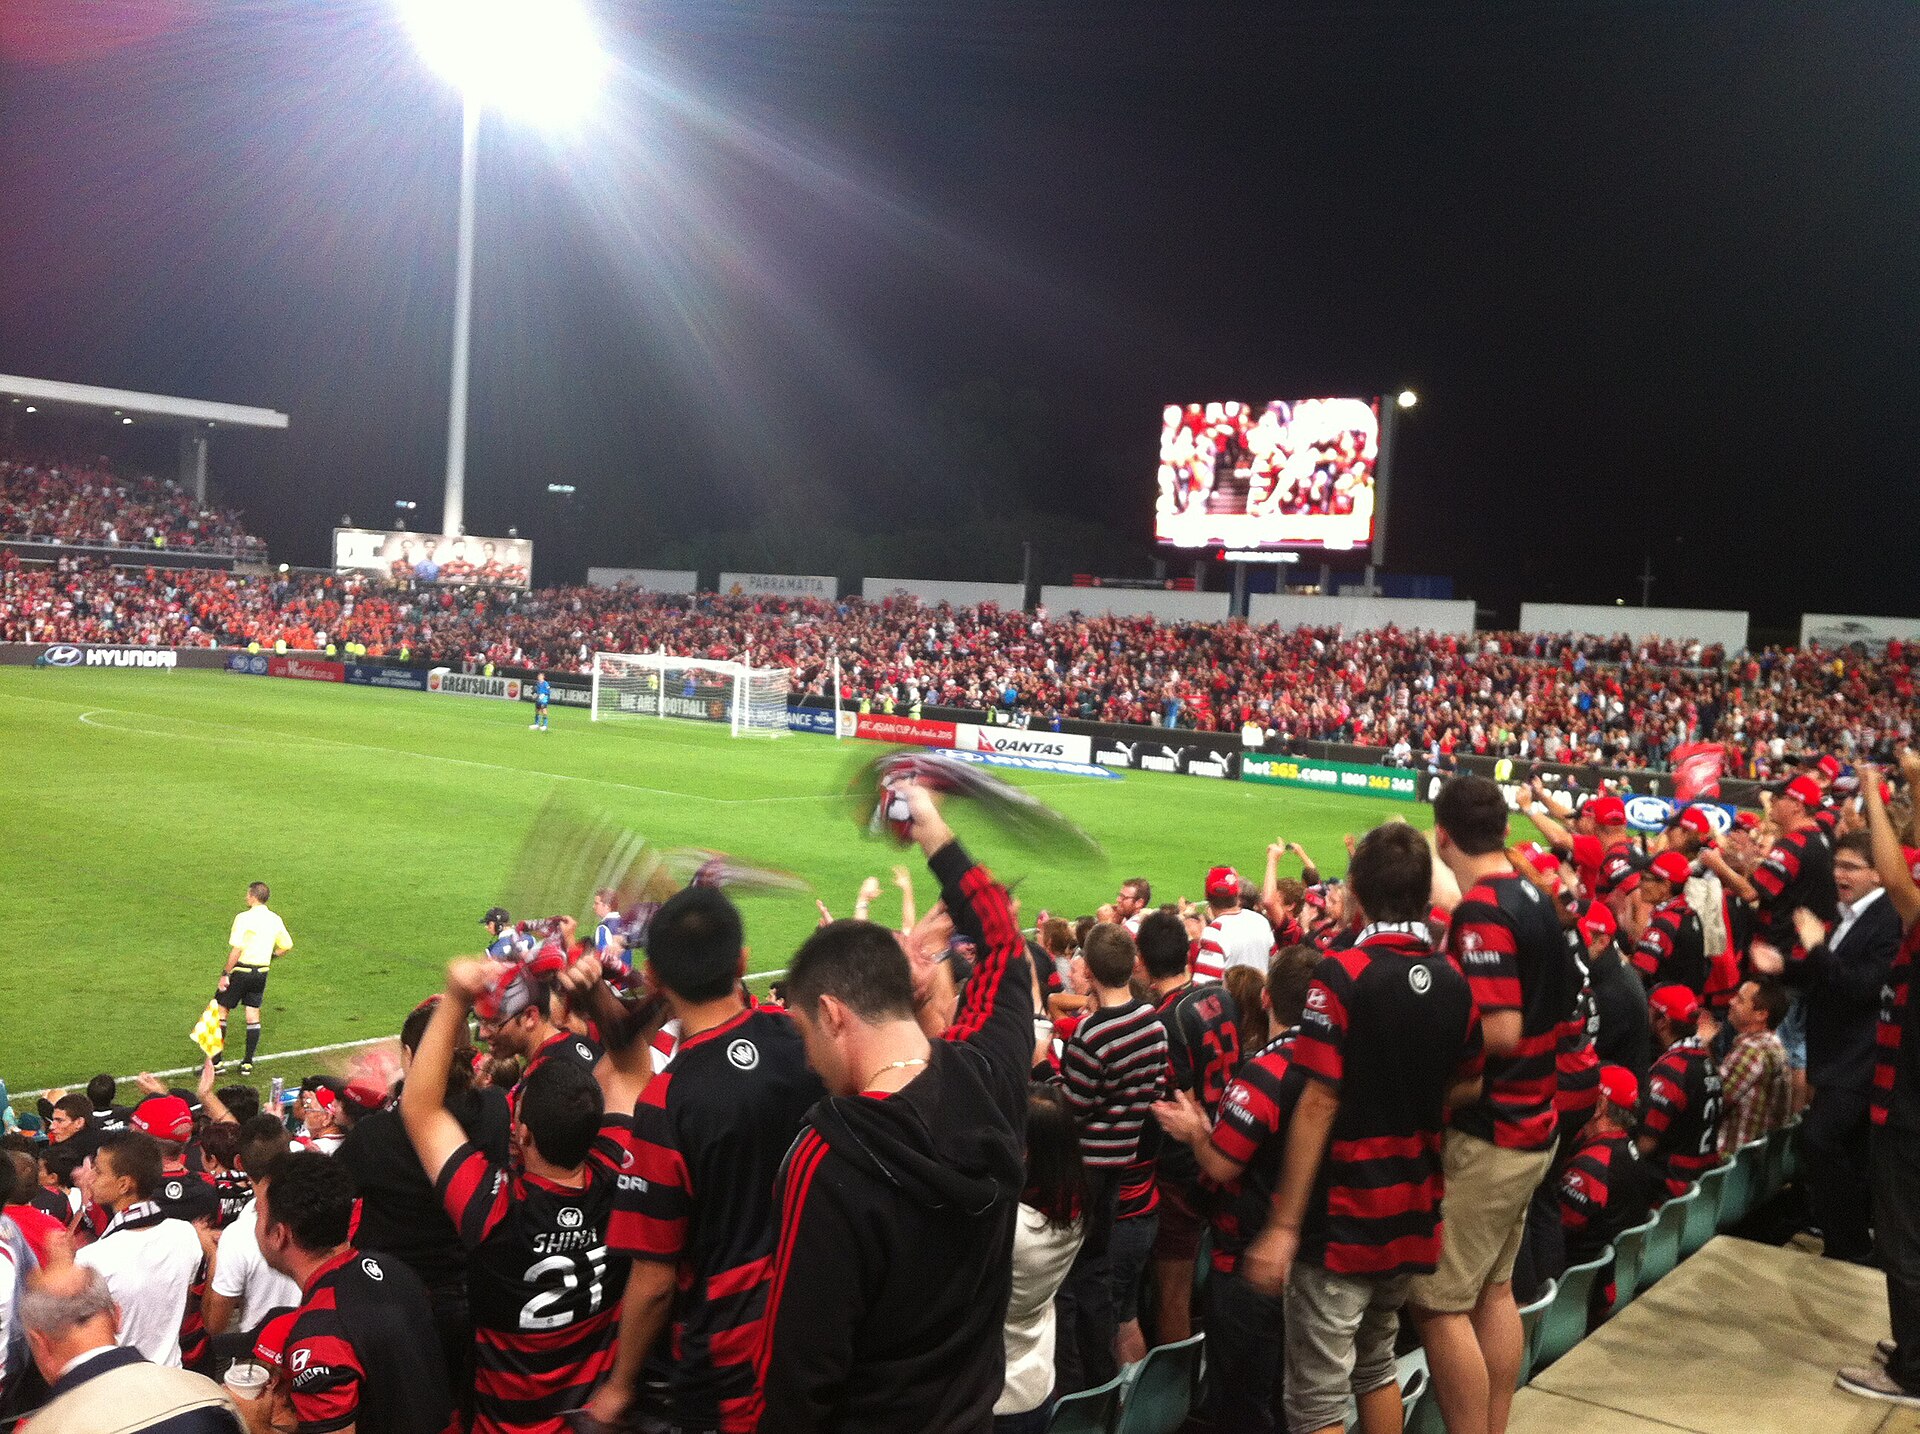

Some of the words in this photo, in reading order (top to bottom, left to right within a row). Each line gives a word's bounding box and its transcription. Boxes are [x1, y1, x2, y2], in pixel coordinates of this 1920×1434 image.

[750, 574, 823, 592] PARRAMATTA
[86, 649, 177, 667] HYUNDAI
[658, 696, 708, 718] OOTBALL
[995, 738, 1064, 756] QANTAS
[1243, 758, 1338, 785] bet365.com
[1368, 775, 1391, 789] 365
[1391, 777, 1414, 792] 365
[533, 1228, 597, 1253] SHINJI
[519, 1245, 607, 1328] 21
